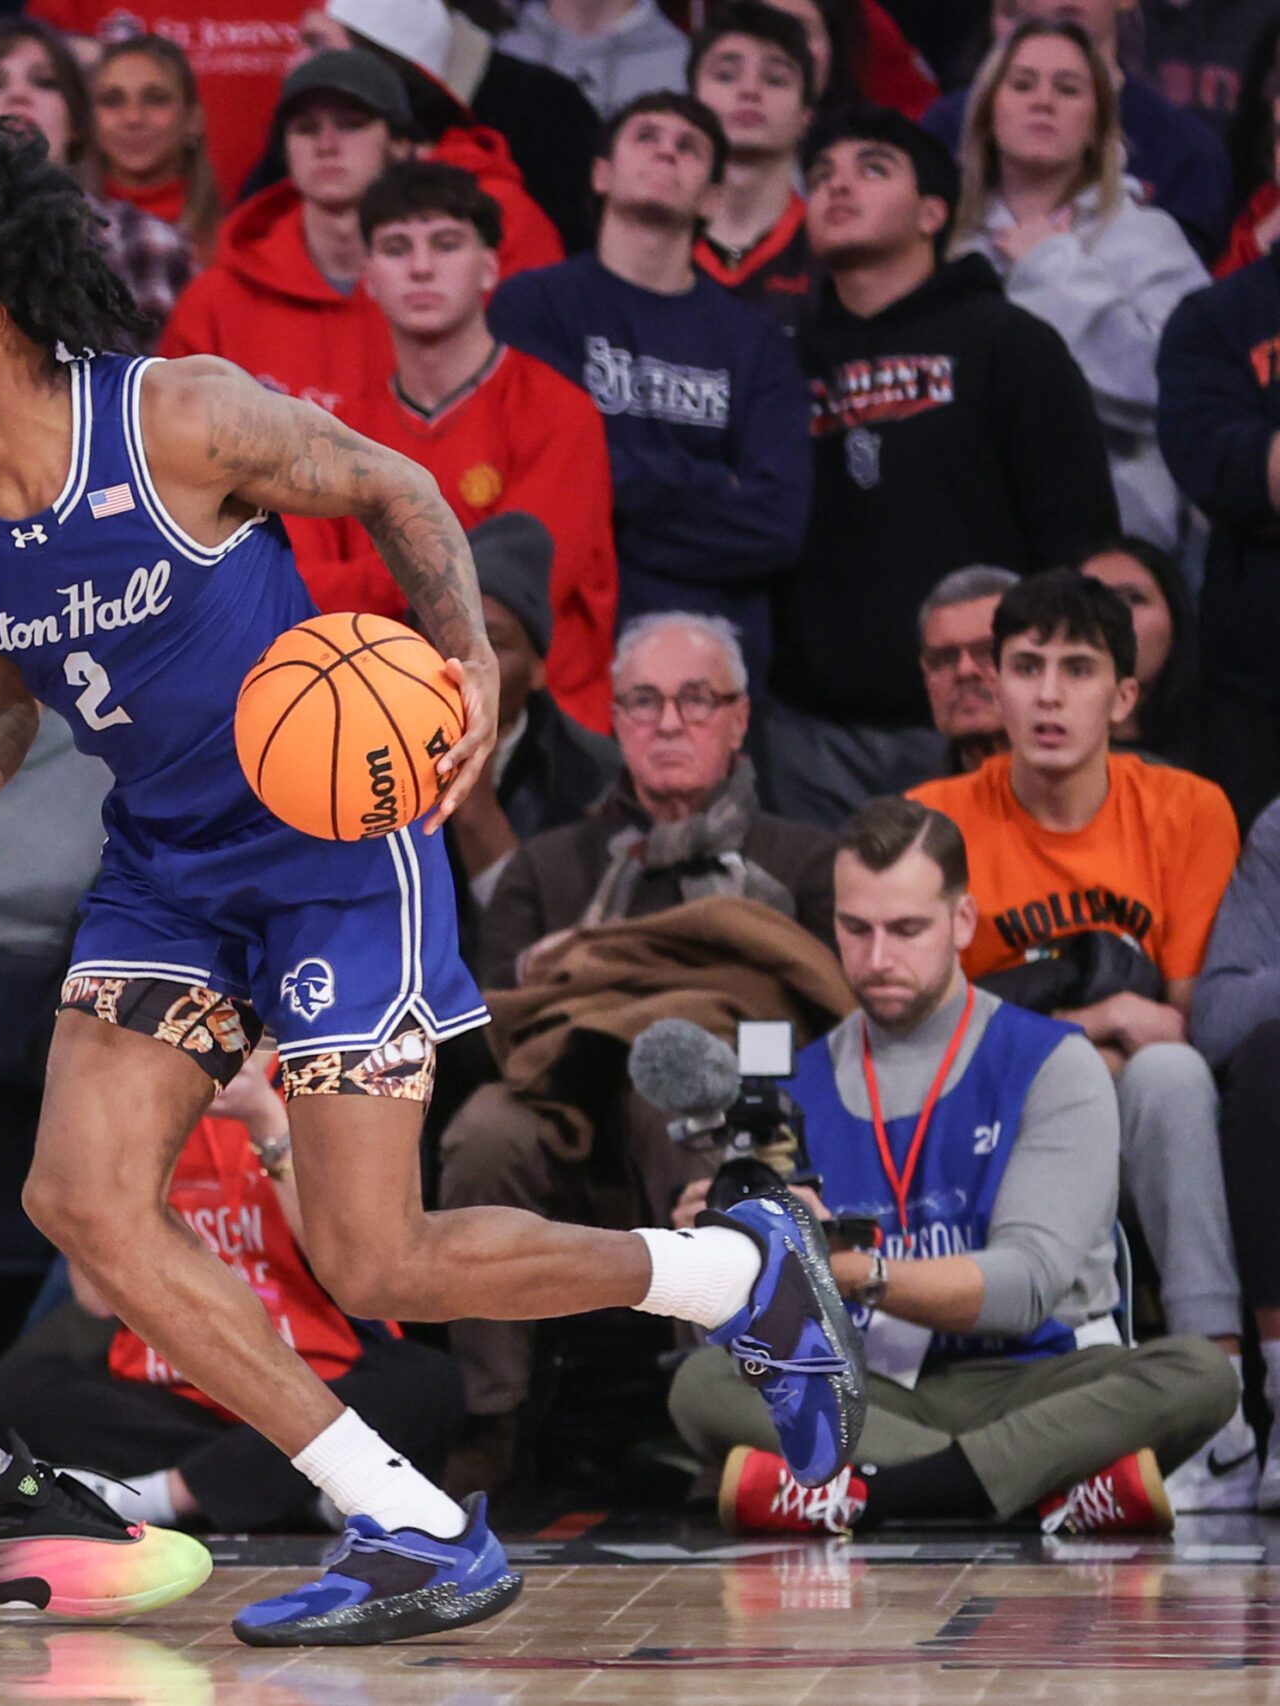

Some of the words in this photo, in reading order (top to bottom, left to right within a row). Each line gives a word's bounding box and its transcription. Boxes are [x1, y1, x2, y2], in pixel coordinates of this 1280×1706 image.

[56, 559, 172, 639] Hall
[63, 651, 133, 731] 2
[360, 744, 398, 839] ilson
